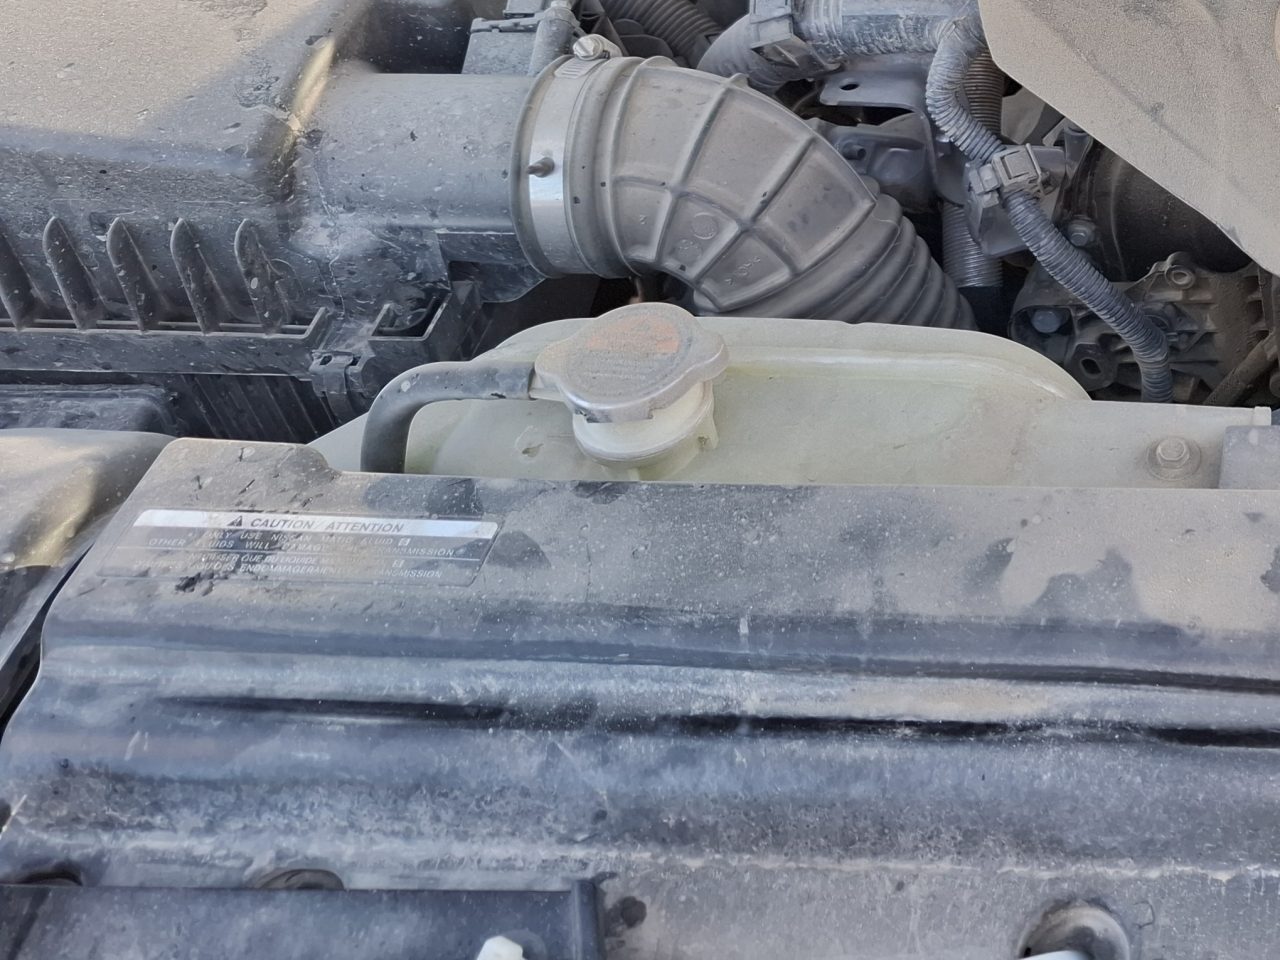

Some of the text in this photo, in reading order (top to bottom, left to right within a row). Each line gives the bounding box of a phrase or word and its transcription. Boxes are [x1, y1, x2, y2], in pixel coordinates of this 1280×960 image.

[250, 518, 314, 530] CAUTION
[325, 521, 404, 533] ATTENTION
[240, 531, 263, 540] USE
[148, 537, 187, 546] OTHER
[194, 539, 235, 549] FUIDS
[245, 541, 270, 550] WILL
